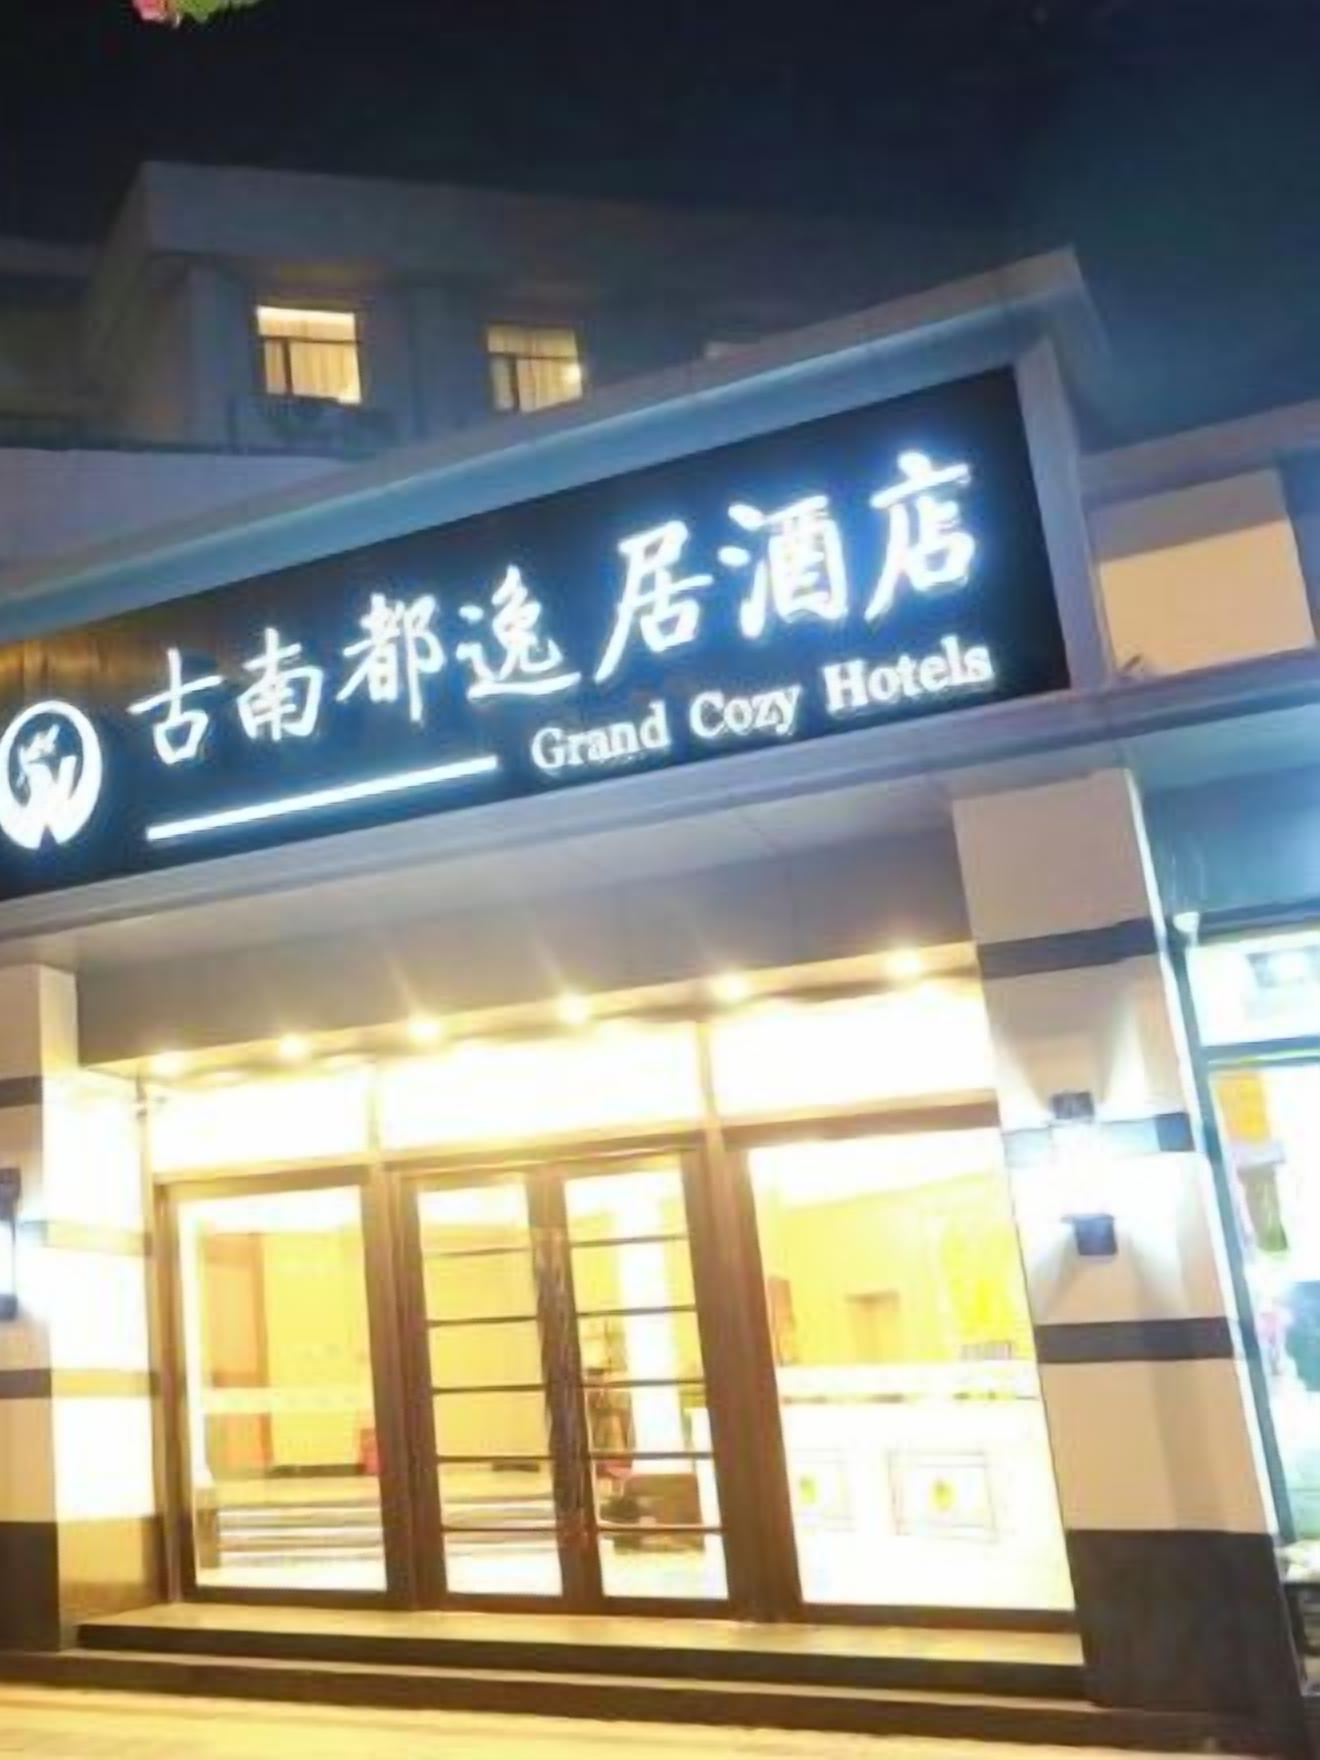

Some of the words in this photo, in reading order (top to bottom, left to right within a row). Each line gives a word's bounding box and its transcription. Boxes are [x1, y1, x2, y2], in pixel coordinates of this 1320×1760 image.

[130, 449, 978, 767] 古南都逸居酒店
[530, 700, 671, 774] Grand
[689, 684, 802, 741] Cozy
[822, 634, 995, 713] Hotels
